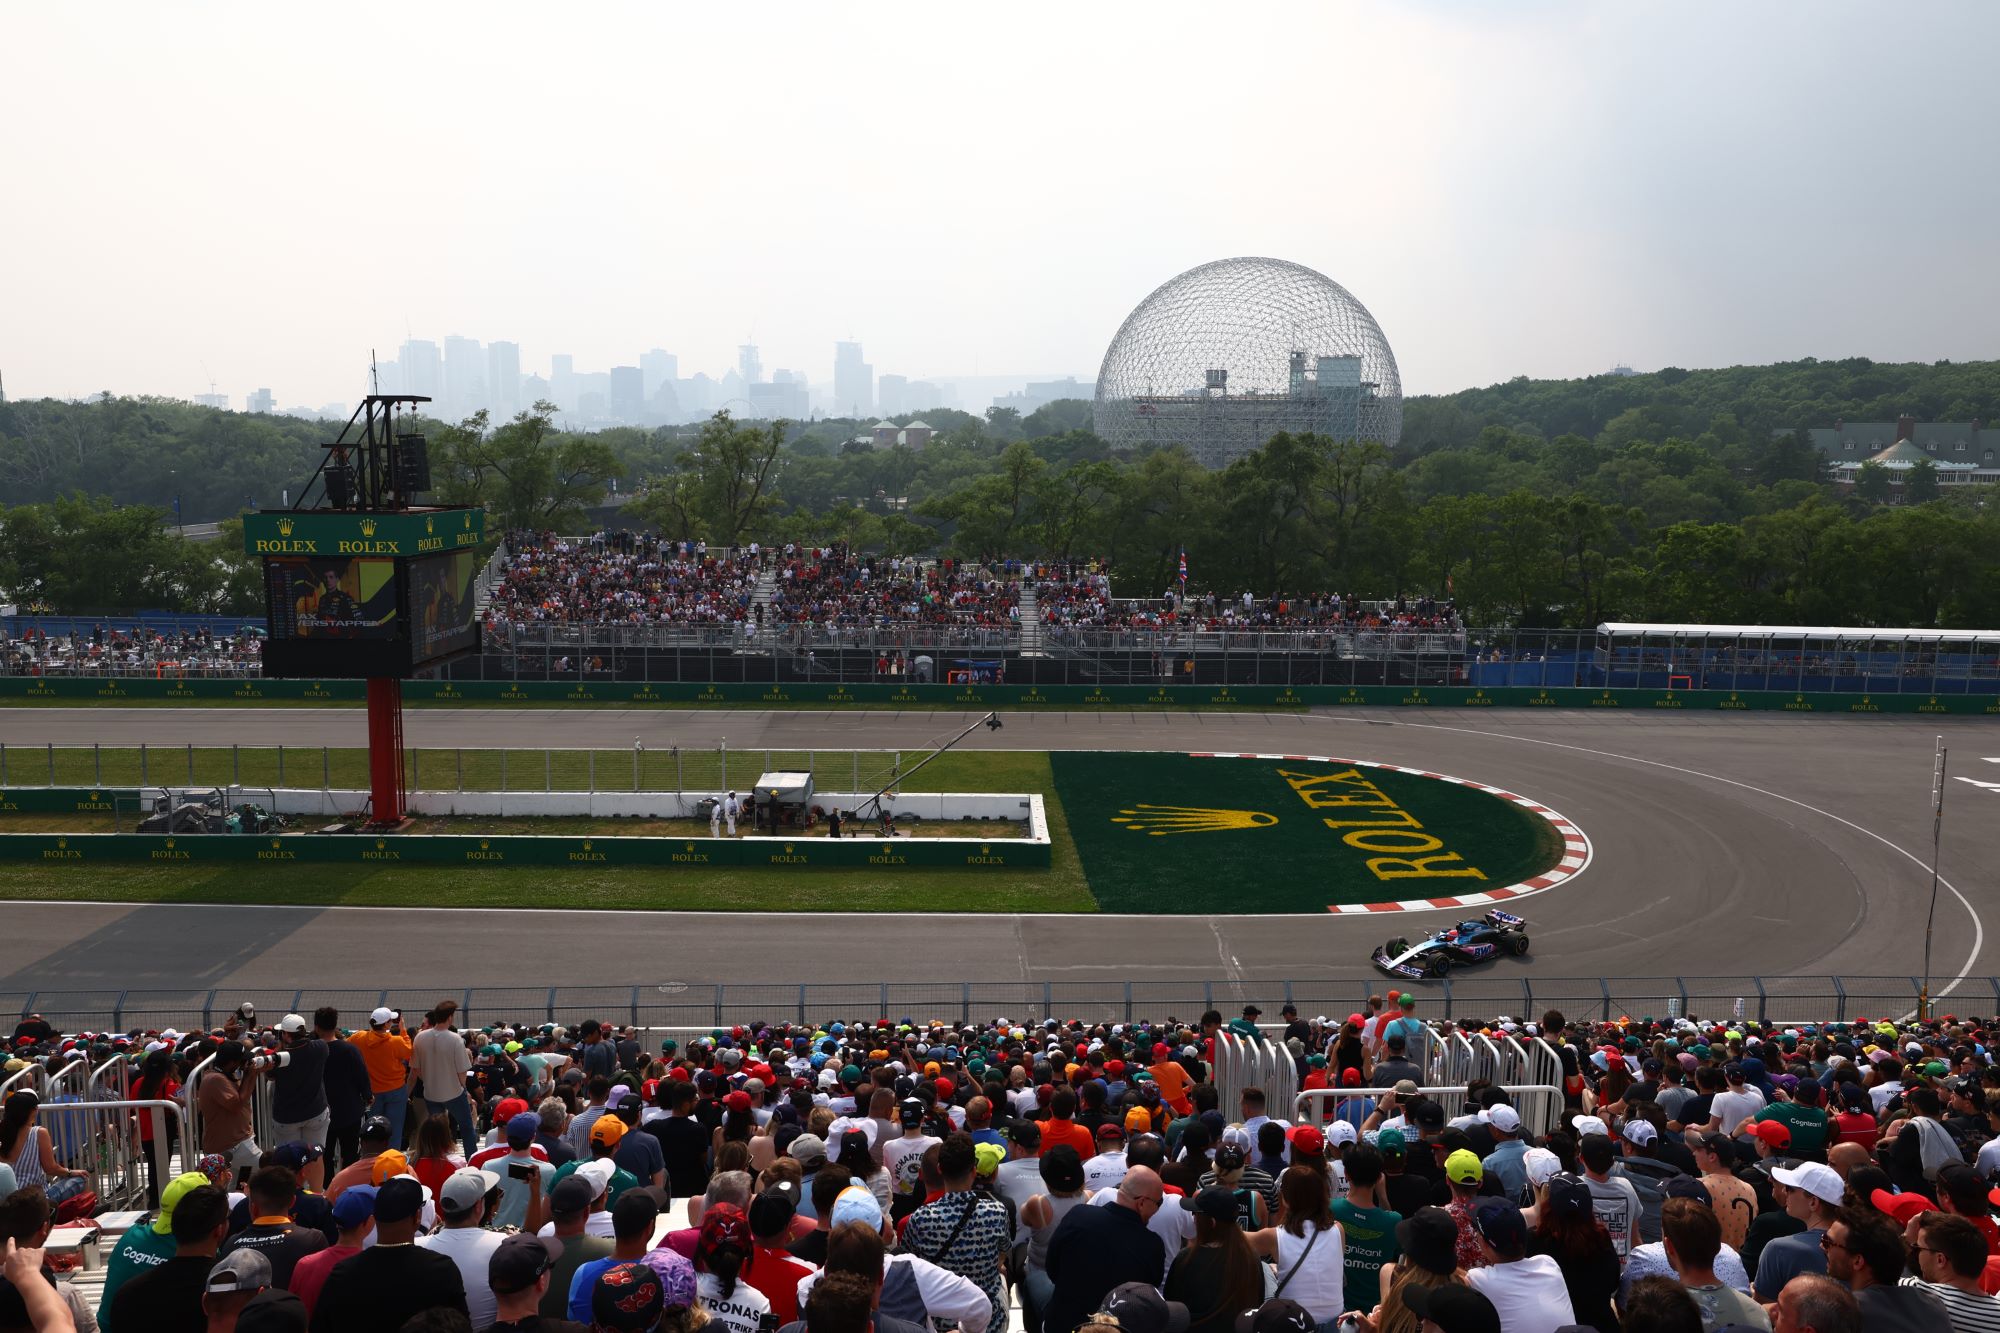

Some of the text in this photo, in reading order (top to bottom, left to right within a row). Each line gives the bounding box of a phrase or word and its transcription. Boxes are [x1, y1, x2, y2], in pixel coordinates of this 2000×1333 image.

[457, 532, 479, 545] ROLEX
[256, 540, 318, 552] ROLEX
[338, 541, 400, 553] ROLEX
[418, 536, 444, 551] ROLEX
[1277, 769, 1489, 881] ROLEX
[151, 851, 190, 859] ROLEX
[466, 852, 504, 860] ROLEX
[569, 853, 607, 861] ROLEX
[672, 854, 709, 862] ROLEX
[771, 856, 807, 864] ROLEX
[869, 856, 905, 864] ROLEX
[1790, 1117, 1822, 1128] Cognizant
